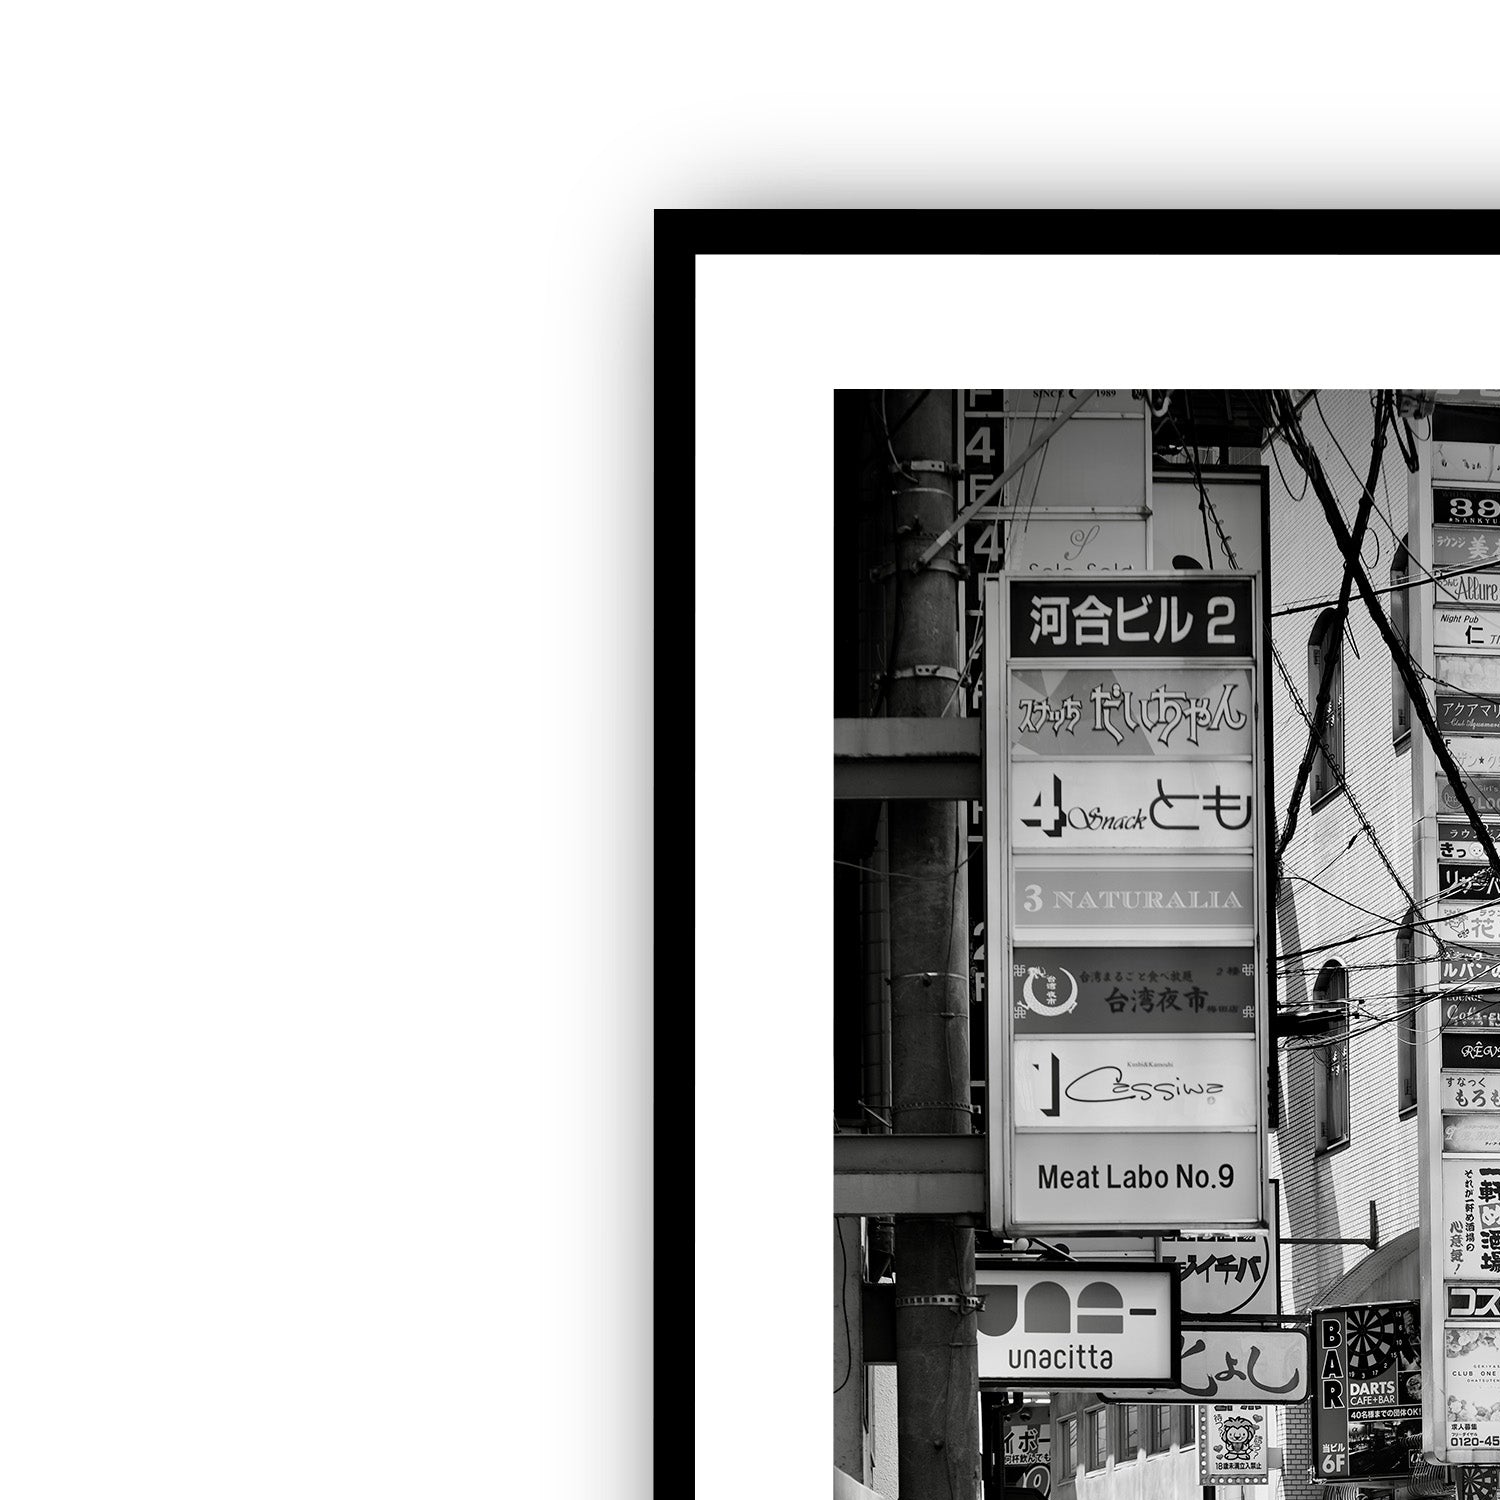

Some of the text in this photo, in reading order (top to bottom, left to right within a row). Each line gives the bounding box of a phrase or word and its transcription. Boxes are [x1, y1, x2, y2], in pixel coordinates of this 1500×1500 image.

[1450, 498, 1500, 518] 39
[1454, 576, 1499, 602] Allure
[1029, 594, 1236, 645] 河合ビル 2
[1440, 614, 1479, 623] Night Pub
[1067, 806, 1148, 831] Snack
[1150, 779, 1252, 830] とも
[1024, 883, 1244, 912] 3 NATURALIA
[1105, 986, 1209, 1014] 台湾夜市
[1446, 1077, 1486, 1088] すなっく
[1038, 1163, 1235, 1189] Meat Labo No.9
[1008, 1344, 1113, 1370] unacitta
[1321, 1318, 1346, 1409] BAR
[1350, 1381, 1396, 1396] DARTS
[1322, 1453, 1346, 1474] 6F
